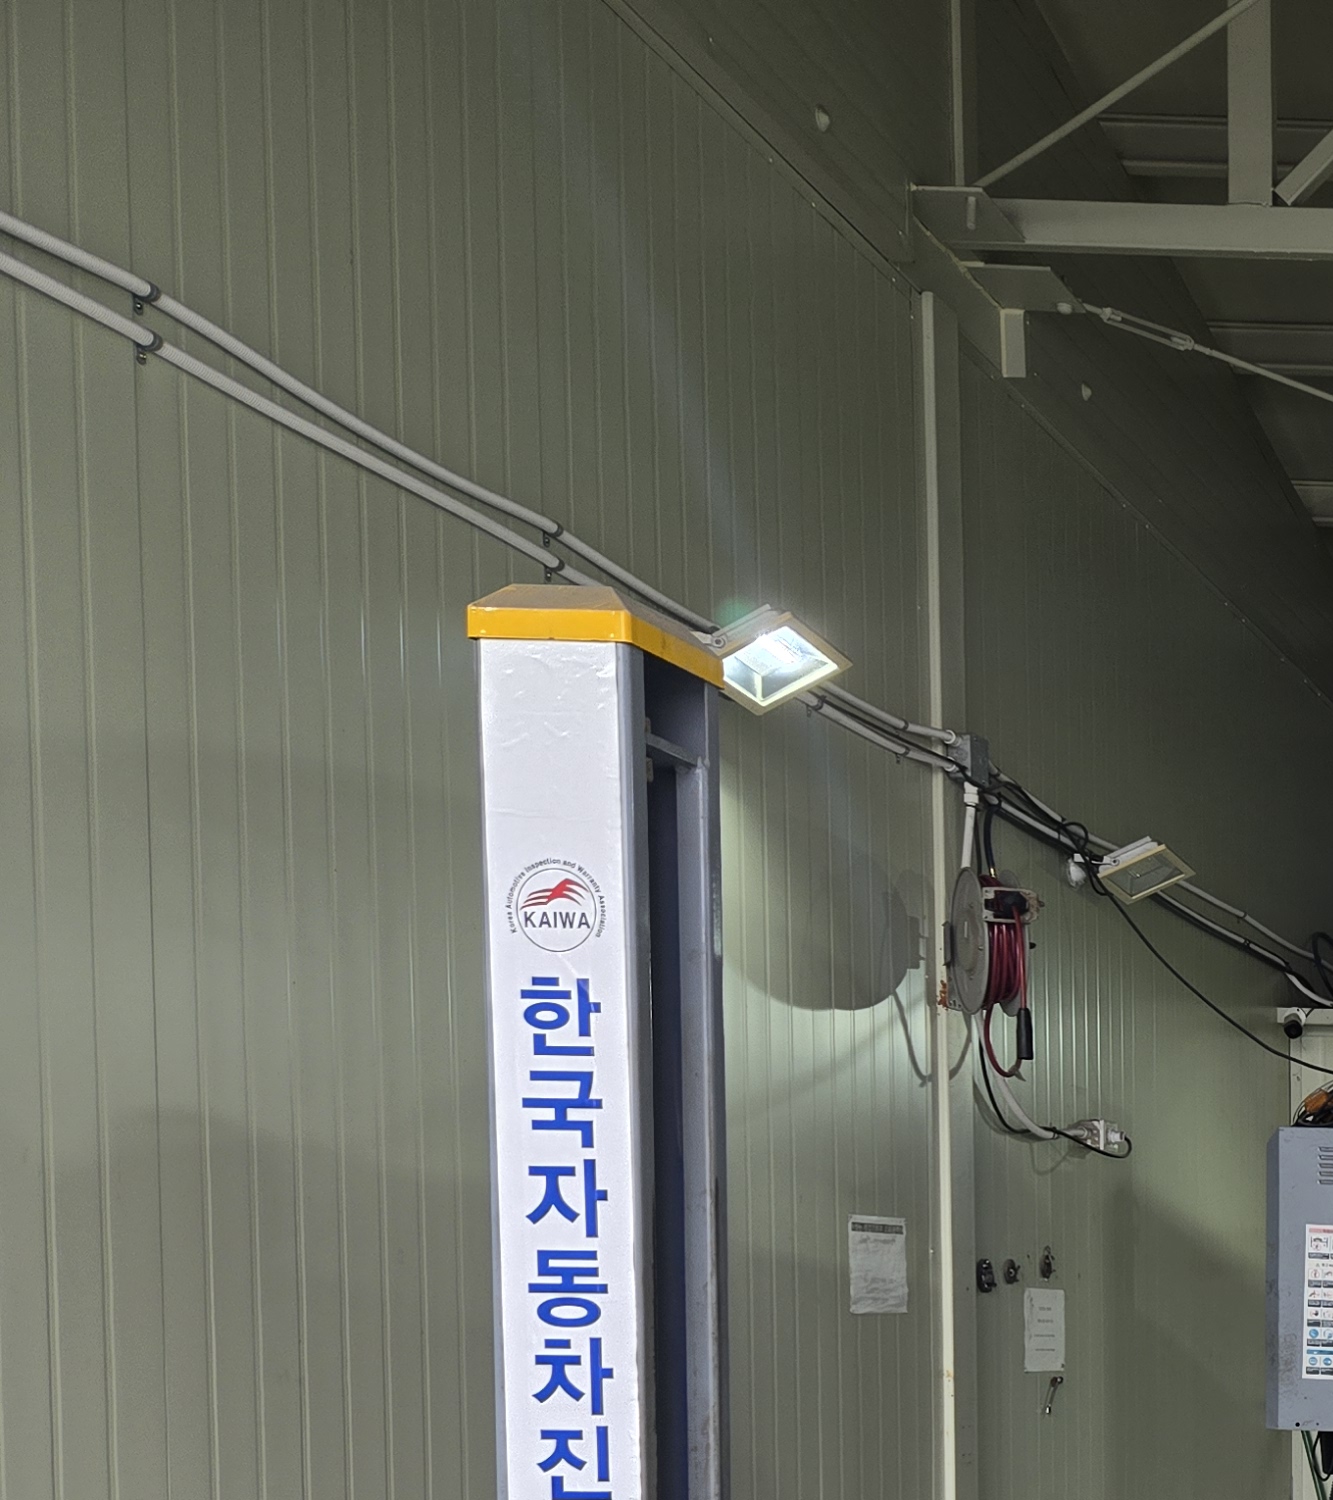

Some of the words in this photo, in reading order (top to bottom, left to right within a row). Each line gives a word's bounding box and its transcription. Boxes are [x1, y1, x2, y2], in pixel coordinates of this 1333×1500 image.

[524, 858, 561, 873] Inspection
[562, 860, 577, 869] and
[577, 864, 603, 893] Warranty
[505, 872, 526, 909] Automotive
[507, 912, 517, 934] Korea
[523, 911, 591, 929] KAIWA
